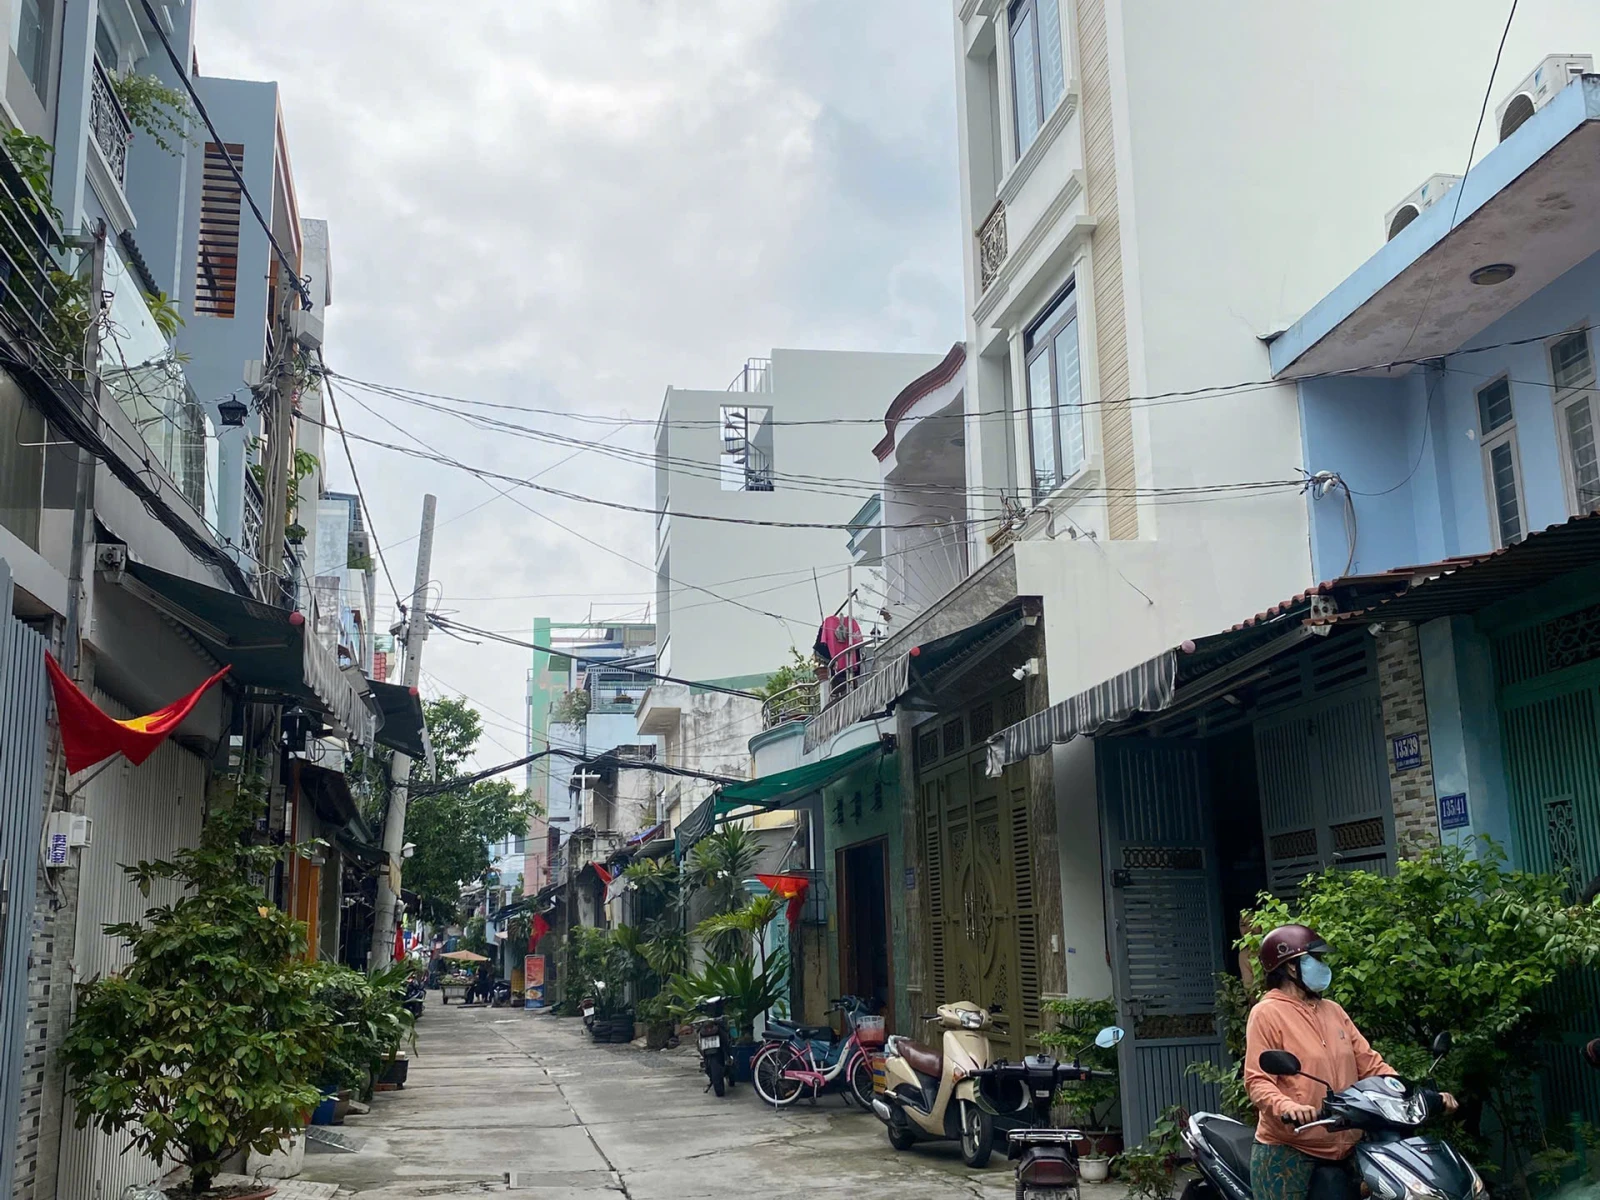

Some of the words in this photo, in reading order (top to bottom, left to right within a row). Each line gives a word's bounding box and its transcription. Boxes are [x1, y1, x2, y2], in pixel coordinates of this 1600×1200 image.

[1395, 737, 1418, 758] 135/39
[1442, 797, 1465, 817] 135/41
[1211, 1164, 1245, 1197] FUTURE
